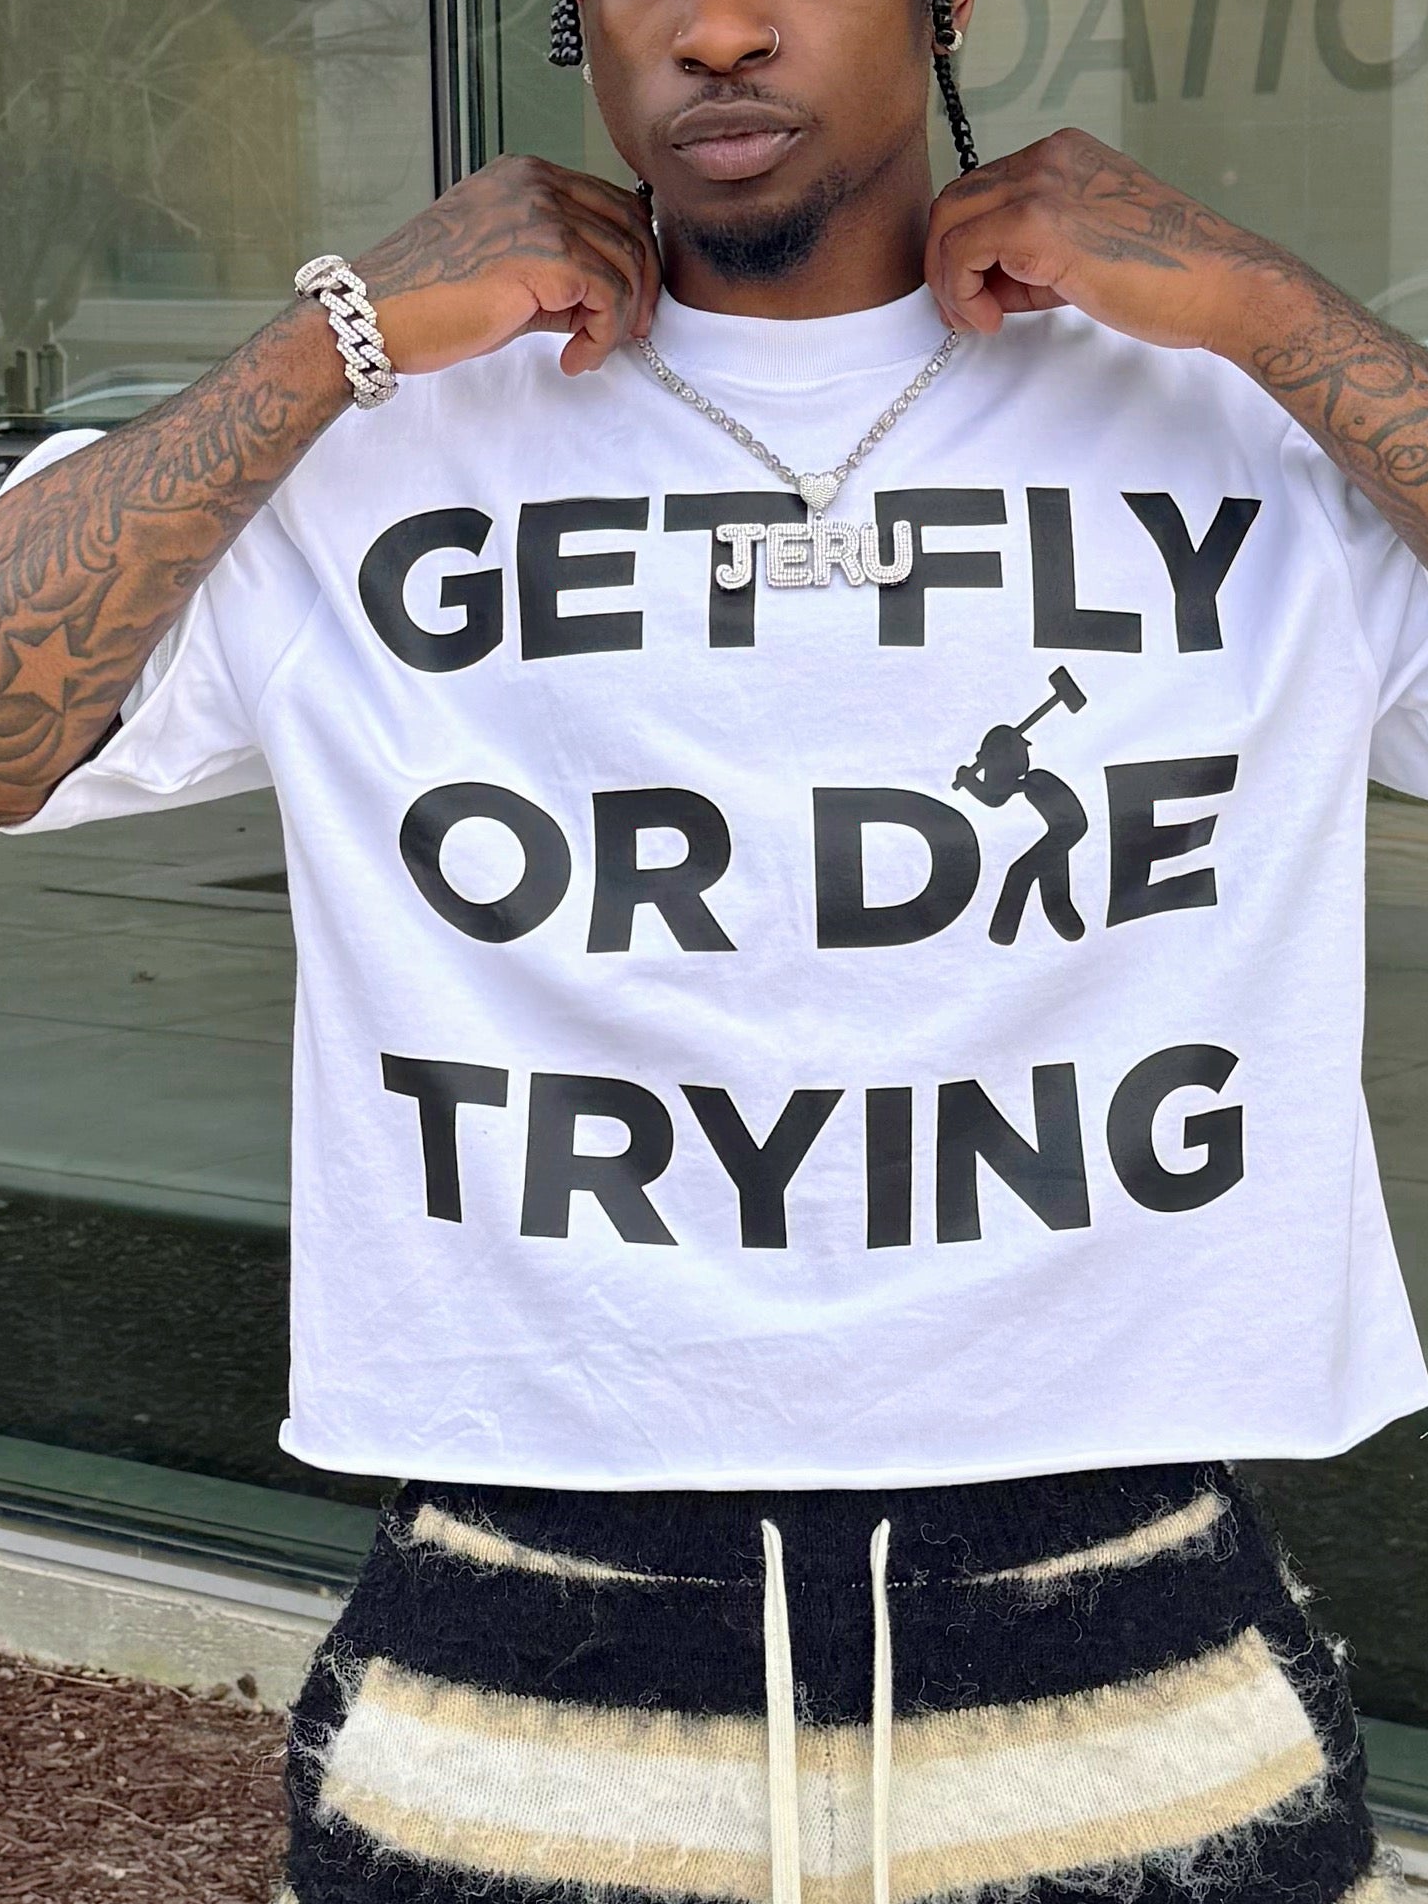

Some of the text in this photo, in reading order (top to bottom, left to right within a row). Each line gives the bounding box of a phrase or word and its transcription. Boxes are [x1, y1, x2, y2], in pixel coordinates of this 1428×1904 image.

[358, 489, 809, 673] GET
[874, 487, 1263, 655] FLY
[715, 519, 914, 590] JERU
[398, 781, 738, 954] OR
[380, 1043, 1245, 1250] TRYING
